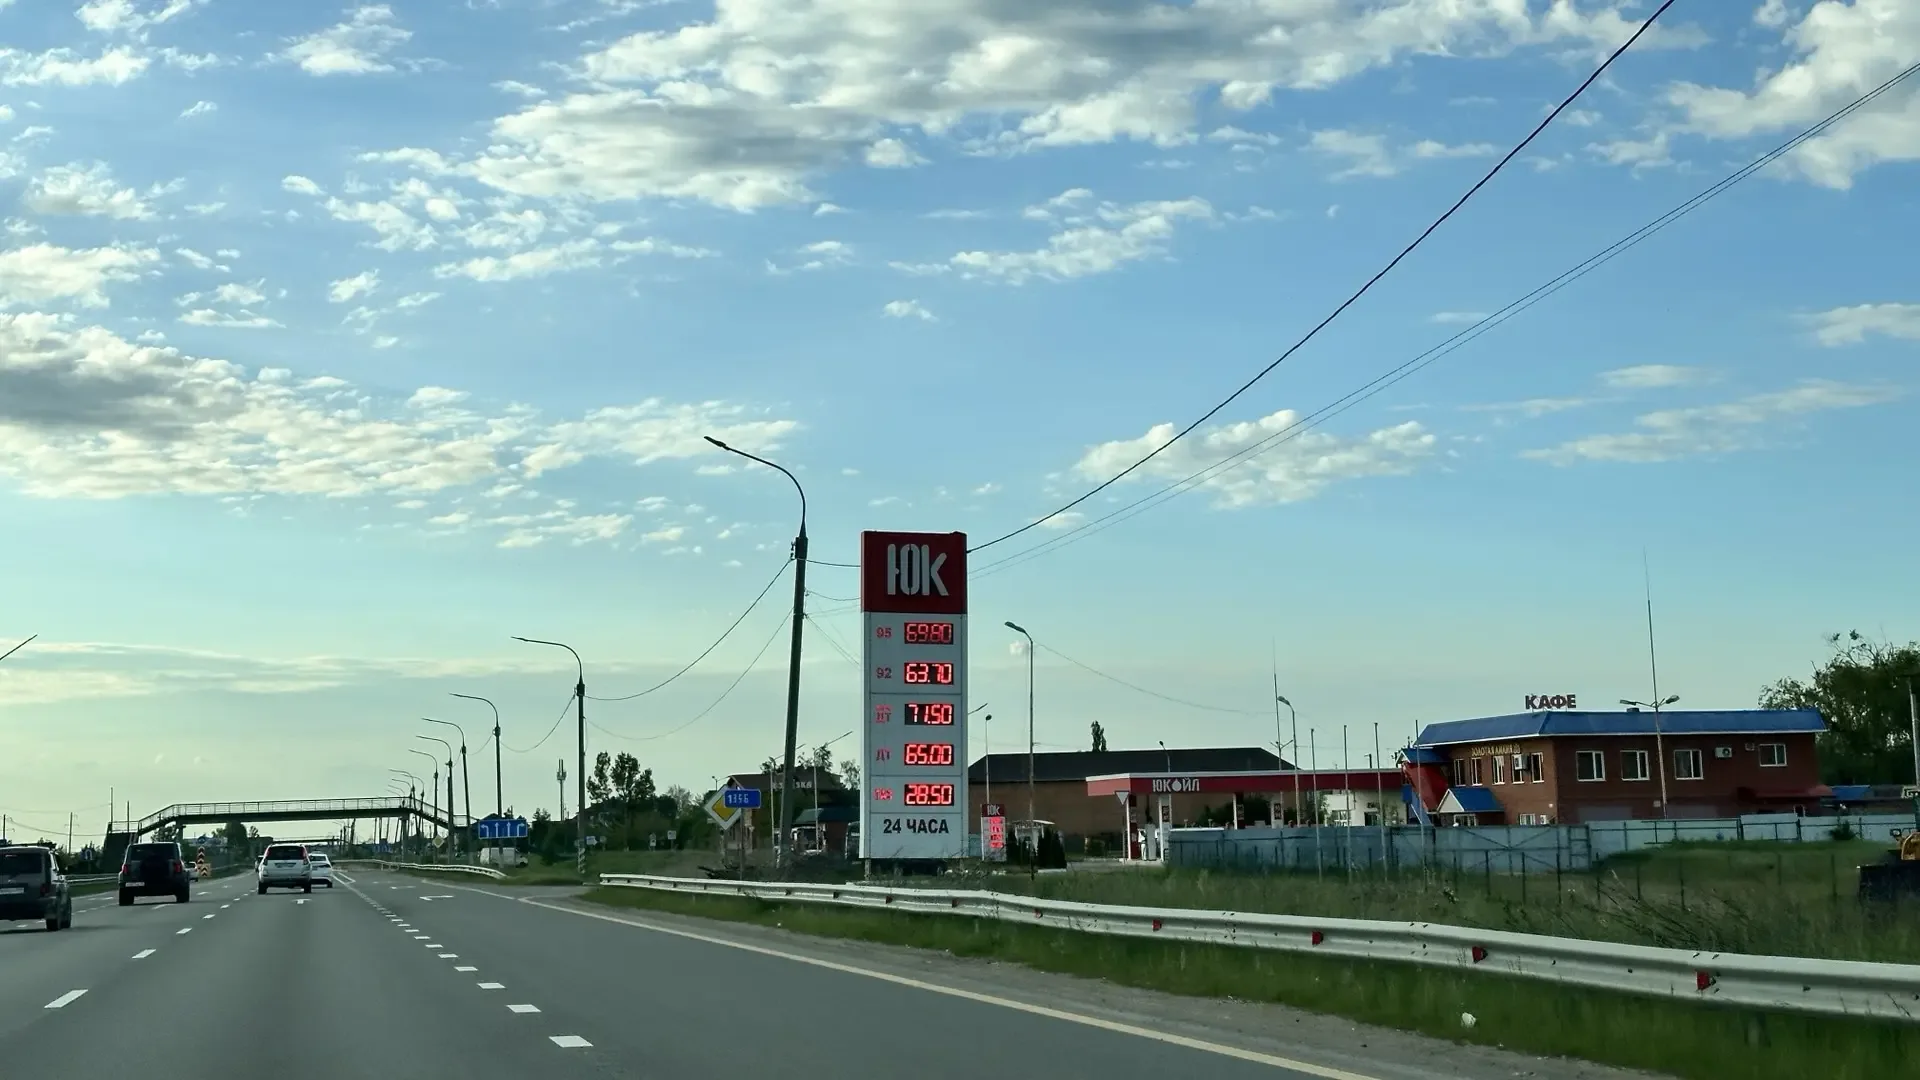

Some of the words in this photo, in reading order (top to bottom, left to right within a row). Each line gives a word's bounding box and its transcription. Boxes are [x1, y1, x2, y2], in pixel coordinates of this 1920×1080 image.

[876, 627, 892, 638] 95
[876, 668, 893, 679] 92
[906, 664, 952, 683] 63.70
[1525, 694, 1577, 709] КАФЕ
[908, 704, 952, 724] 71.50
[906, 745, 952, 764] 65.00
[906, 785, 952, 805] 28.50
[883, 819, 901, 834] 24
[906, 819, 949, 834] ЧАСА
